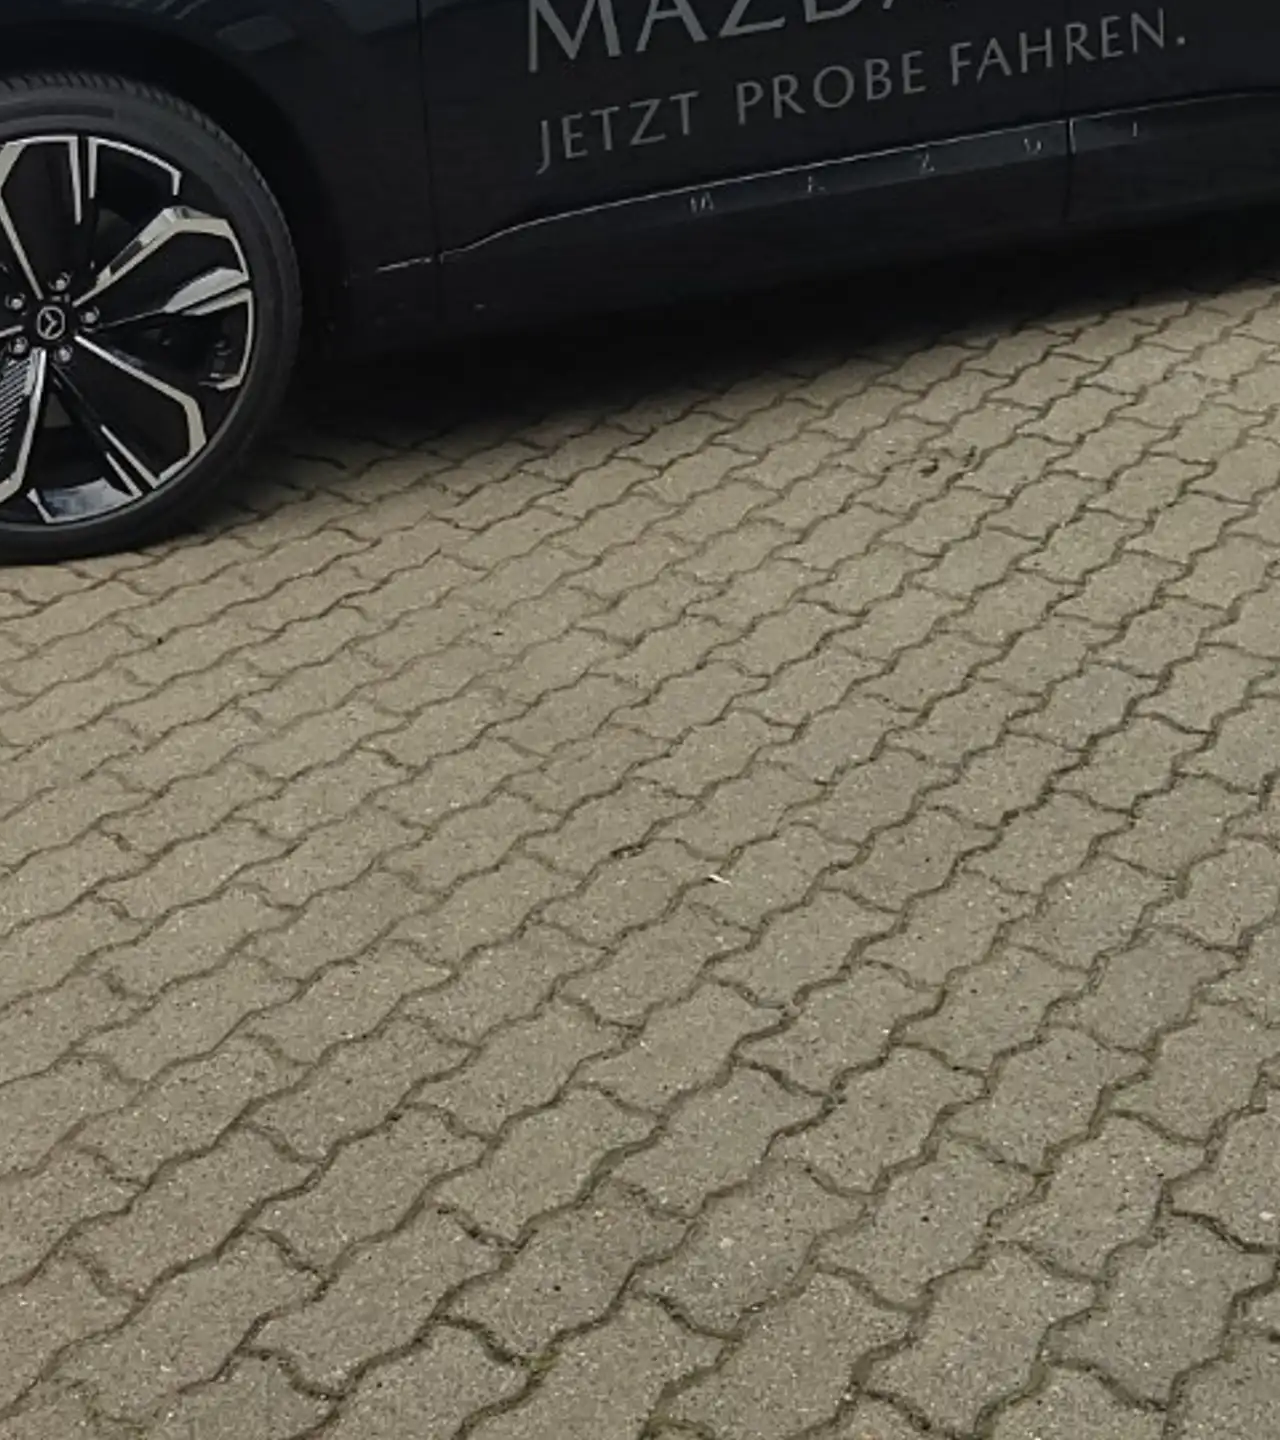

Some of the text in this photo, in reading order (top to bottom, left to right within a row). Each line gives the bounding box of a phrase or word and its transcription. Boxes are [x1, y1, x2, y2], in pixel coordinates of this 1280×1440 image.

[536, 7, 1187, 176] JETZT PROBE FAHREN.
